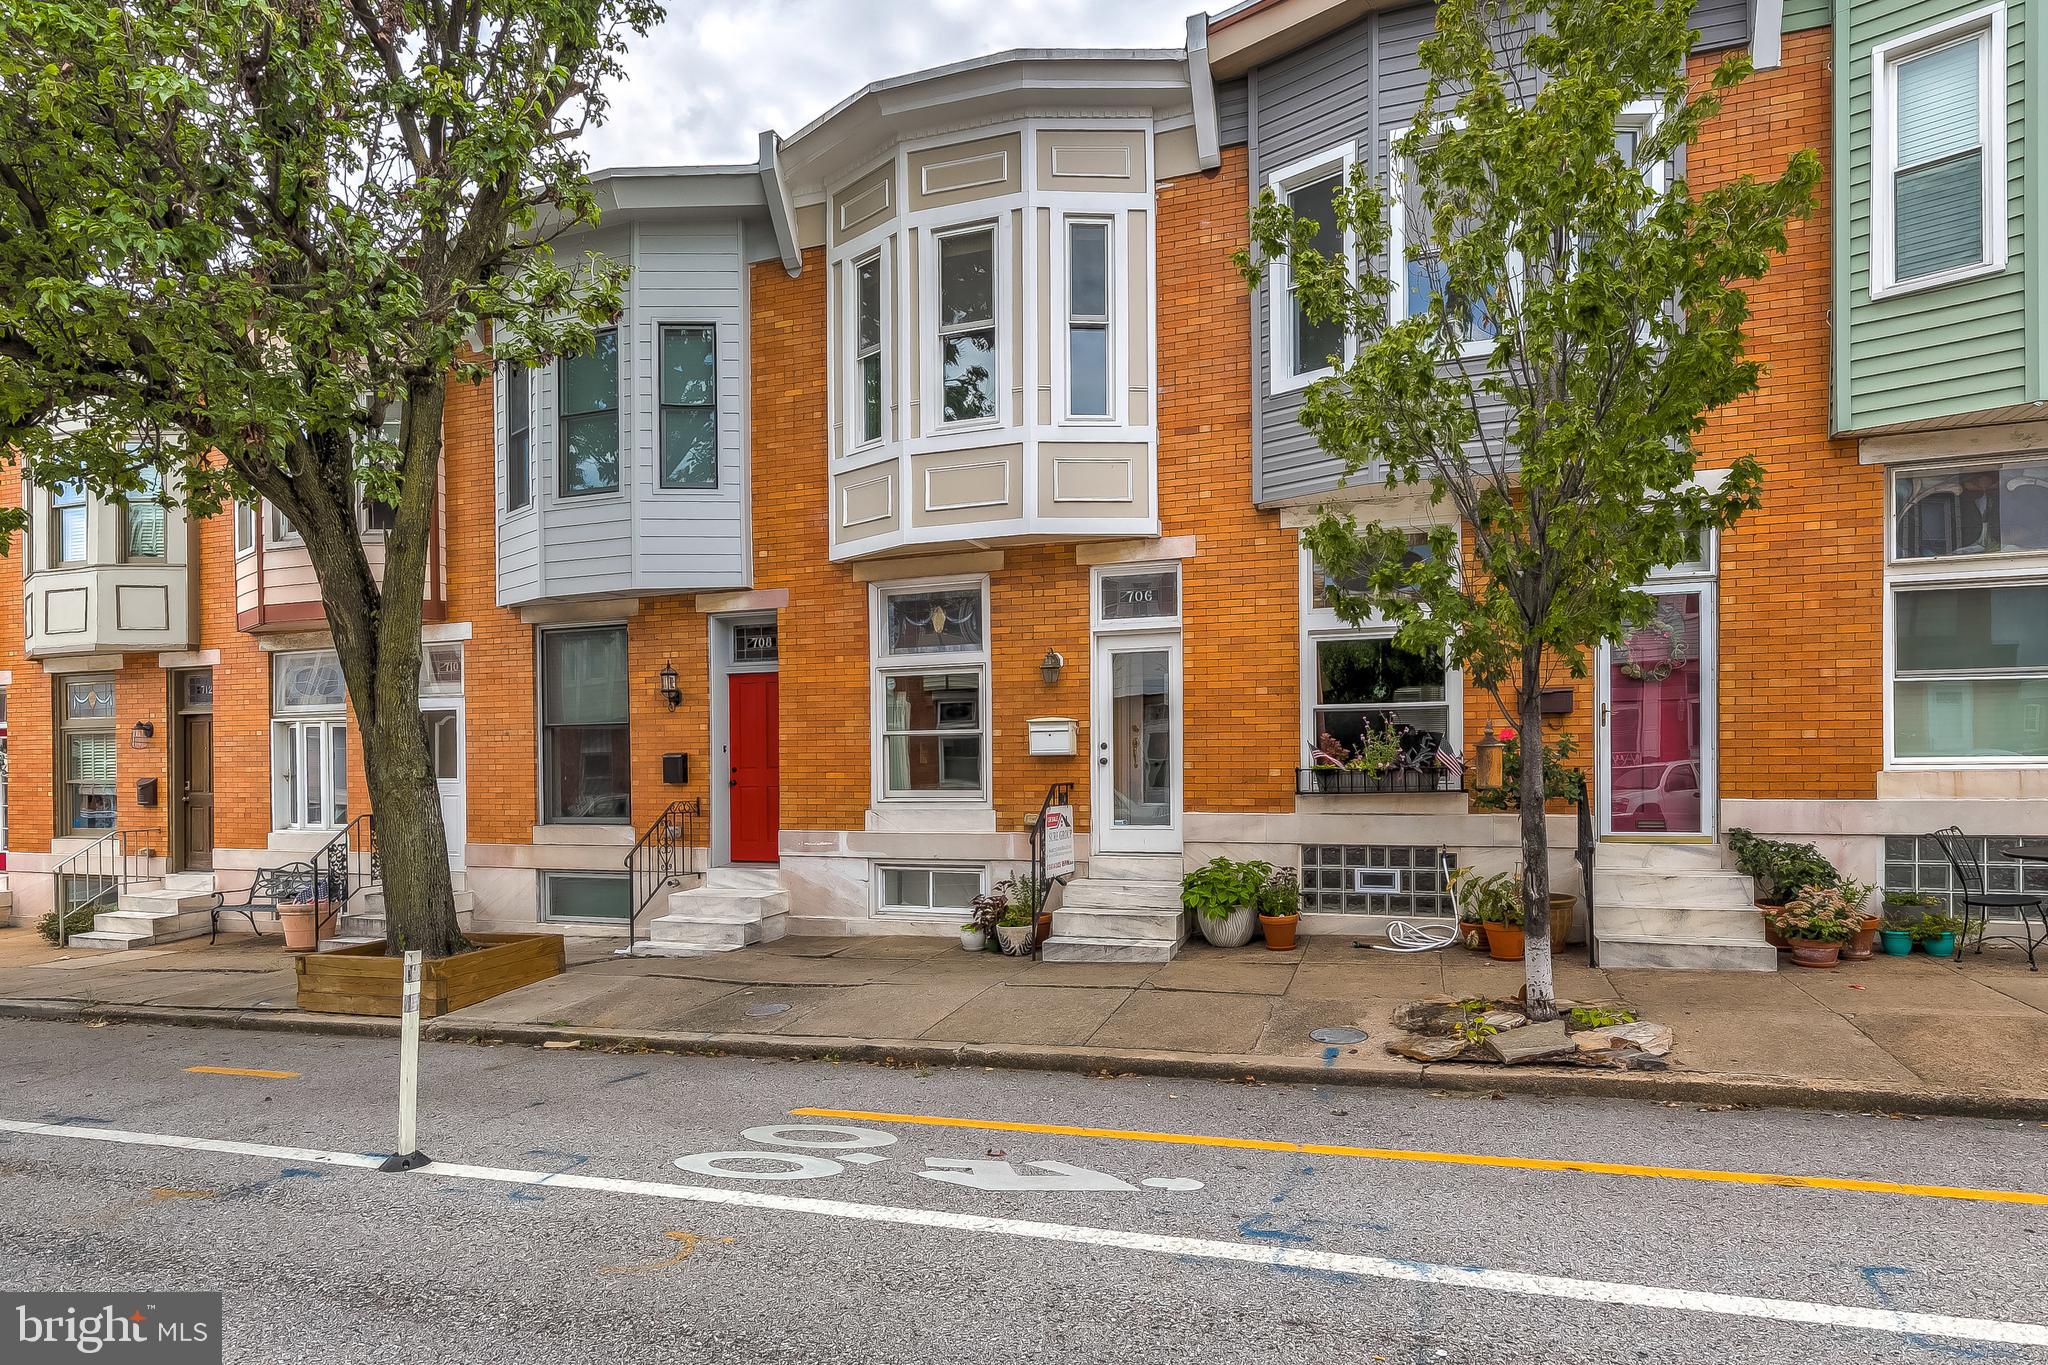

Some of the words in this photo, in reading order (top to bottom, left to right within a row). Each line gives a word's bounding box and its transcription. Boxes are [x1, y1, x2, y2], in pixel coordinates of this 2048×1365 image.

[1120, 590, 1153, 603] 706
[748, 636, 772, 648] 708
[440, 661, 459, 672] 710
[200, 685, 213, 694] 712
